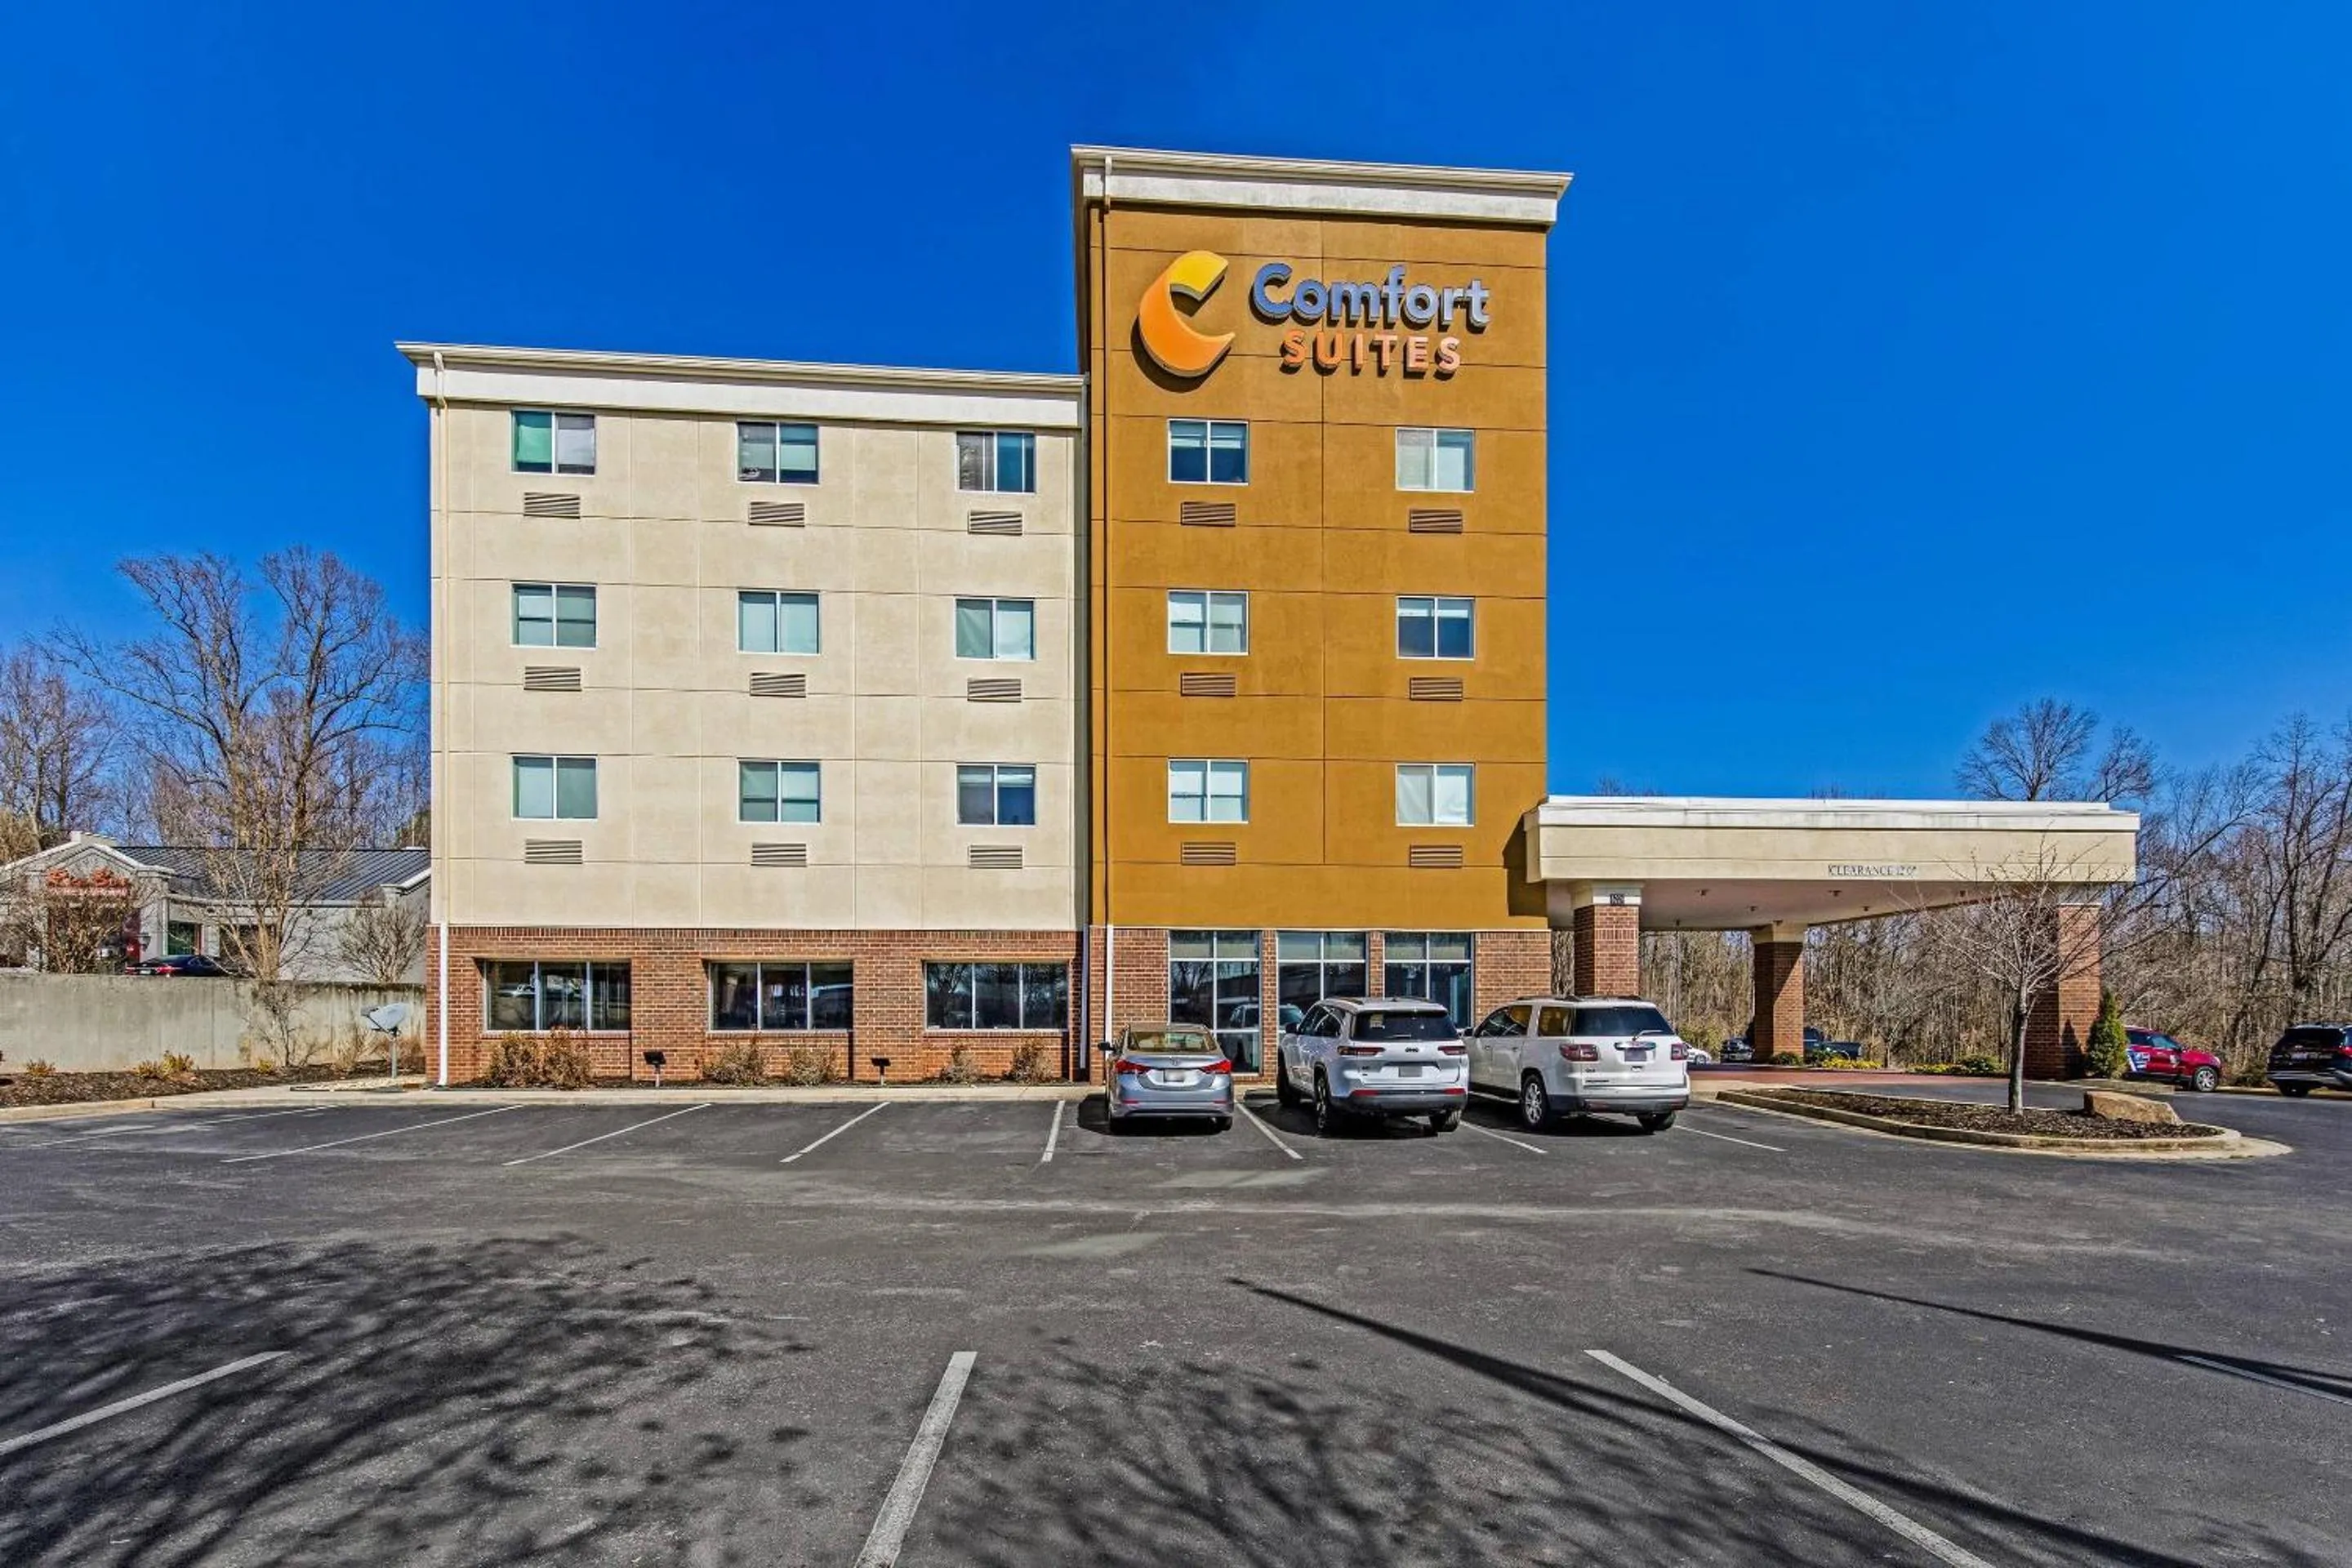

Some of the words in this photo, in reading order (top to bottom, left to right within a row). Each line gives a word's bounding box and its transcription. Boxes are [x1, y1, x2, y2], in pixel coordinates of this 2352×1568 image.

[1252, 262, 1491, 326] Comfort
[1282, 329, 1461, 373] SUITES
[1829, 865, 1894, 877] CLEARANCE
